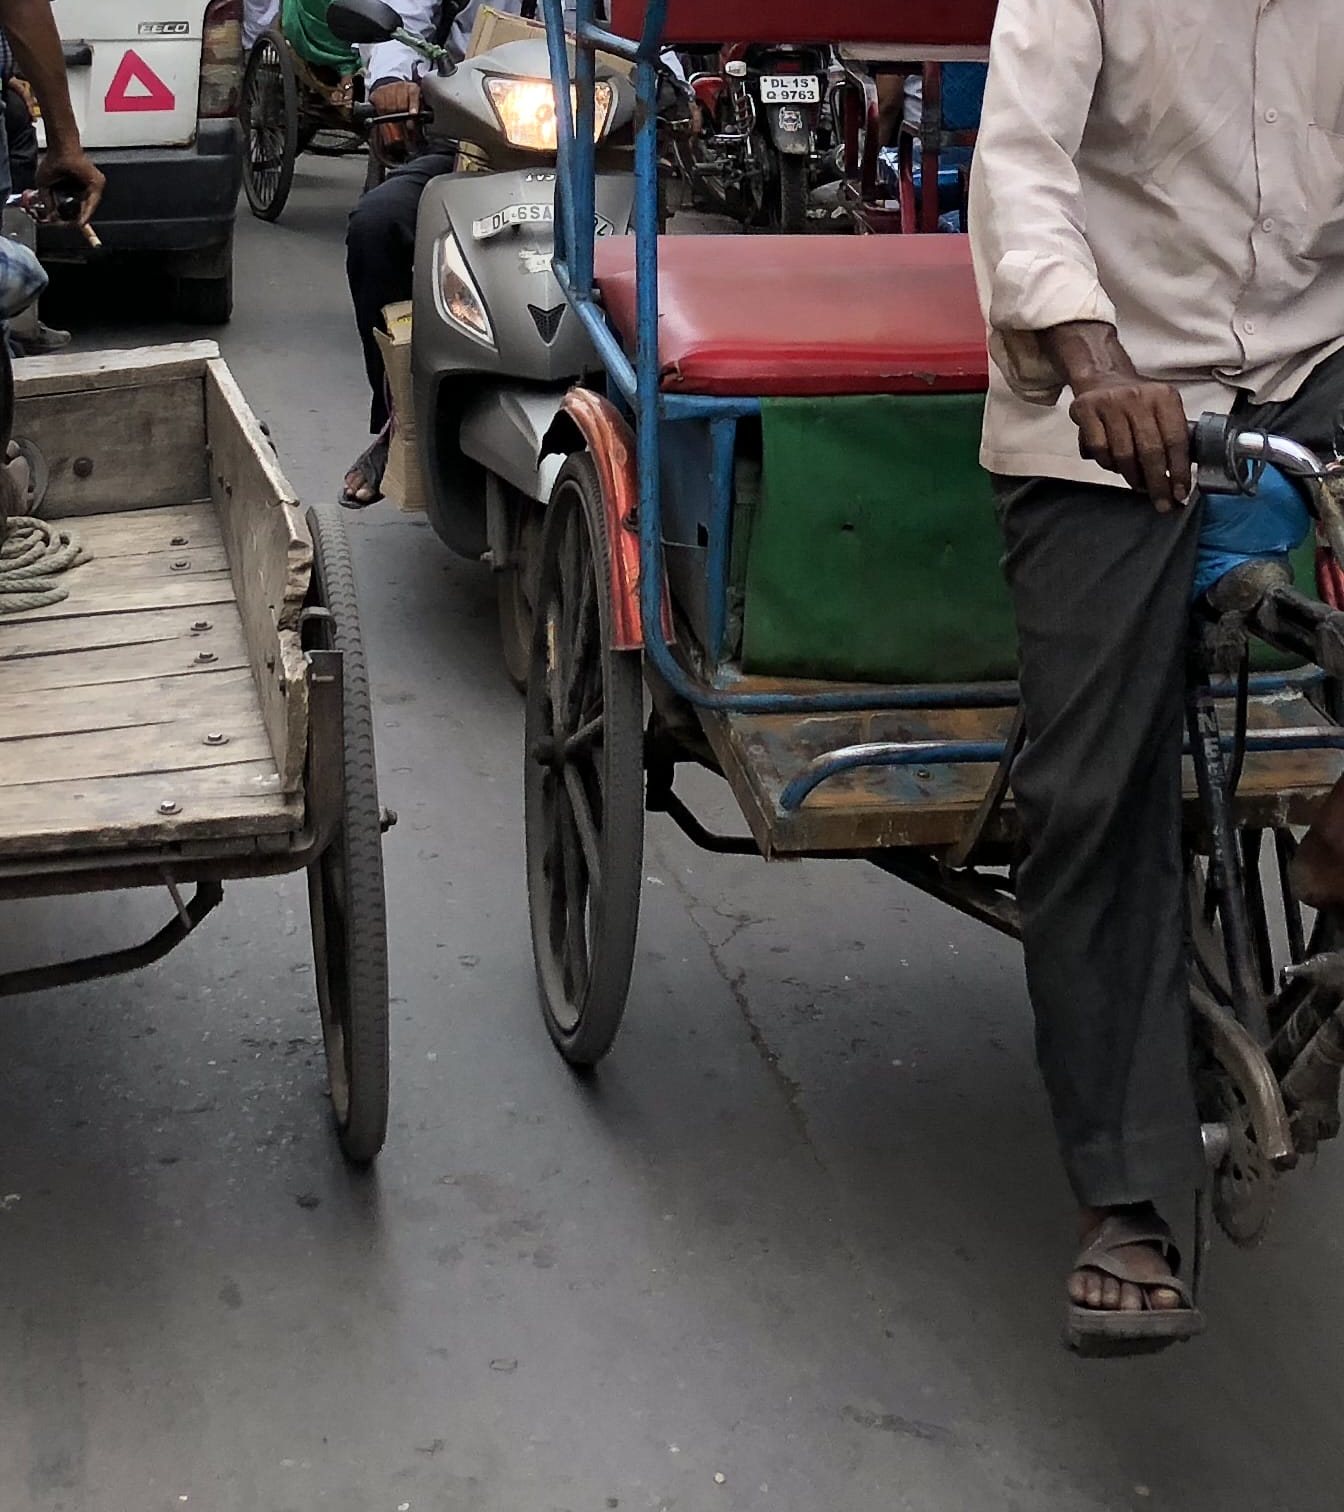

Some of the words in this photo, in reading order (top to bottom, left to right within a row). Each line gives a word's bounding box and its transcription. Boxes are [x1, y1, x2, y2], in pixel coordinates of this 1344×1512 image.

[140, 23, 187, 34] EECO
[771, 78, 789, 88] DL
[792, 78, 809, 88] 1S
[781, 90, 815, 100] 9763
[492, 211, 510, 231] DL
